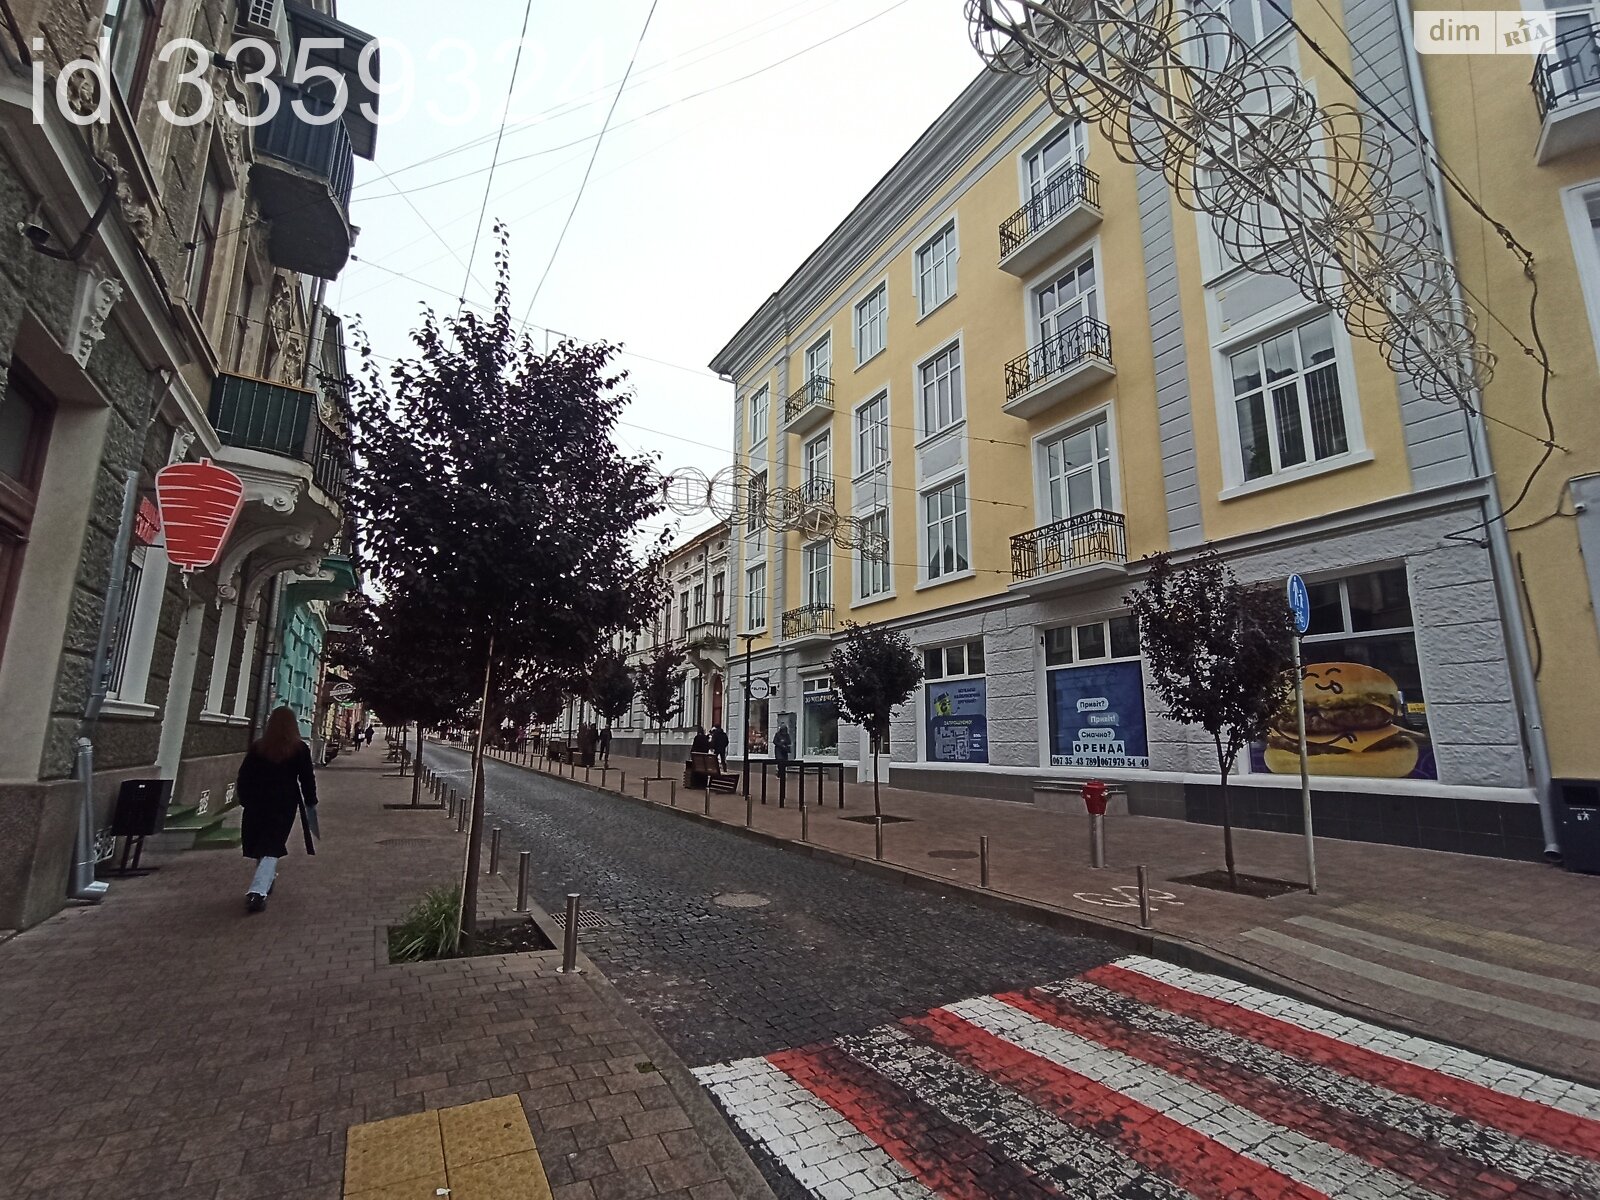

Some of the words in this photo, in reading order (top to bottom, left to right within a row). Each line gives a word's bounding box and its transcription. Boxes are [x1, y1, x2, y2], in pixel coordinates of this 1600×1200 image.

[1080, 701, 1105, 709] Привіт?
[1090, 715, 1115, 723] Привіт!
[1081, 730, 1111, 738] Смачно?
[1074, 743, 1124, 754] ОРЕНДА
[1064, 756, 1073, 764] 35
[1127, 758, 1136, 767] 54
[1140, 759, 1149, 768] 49
